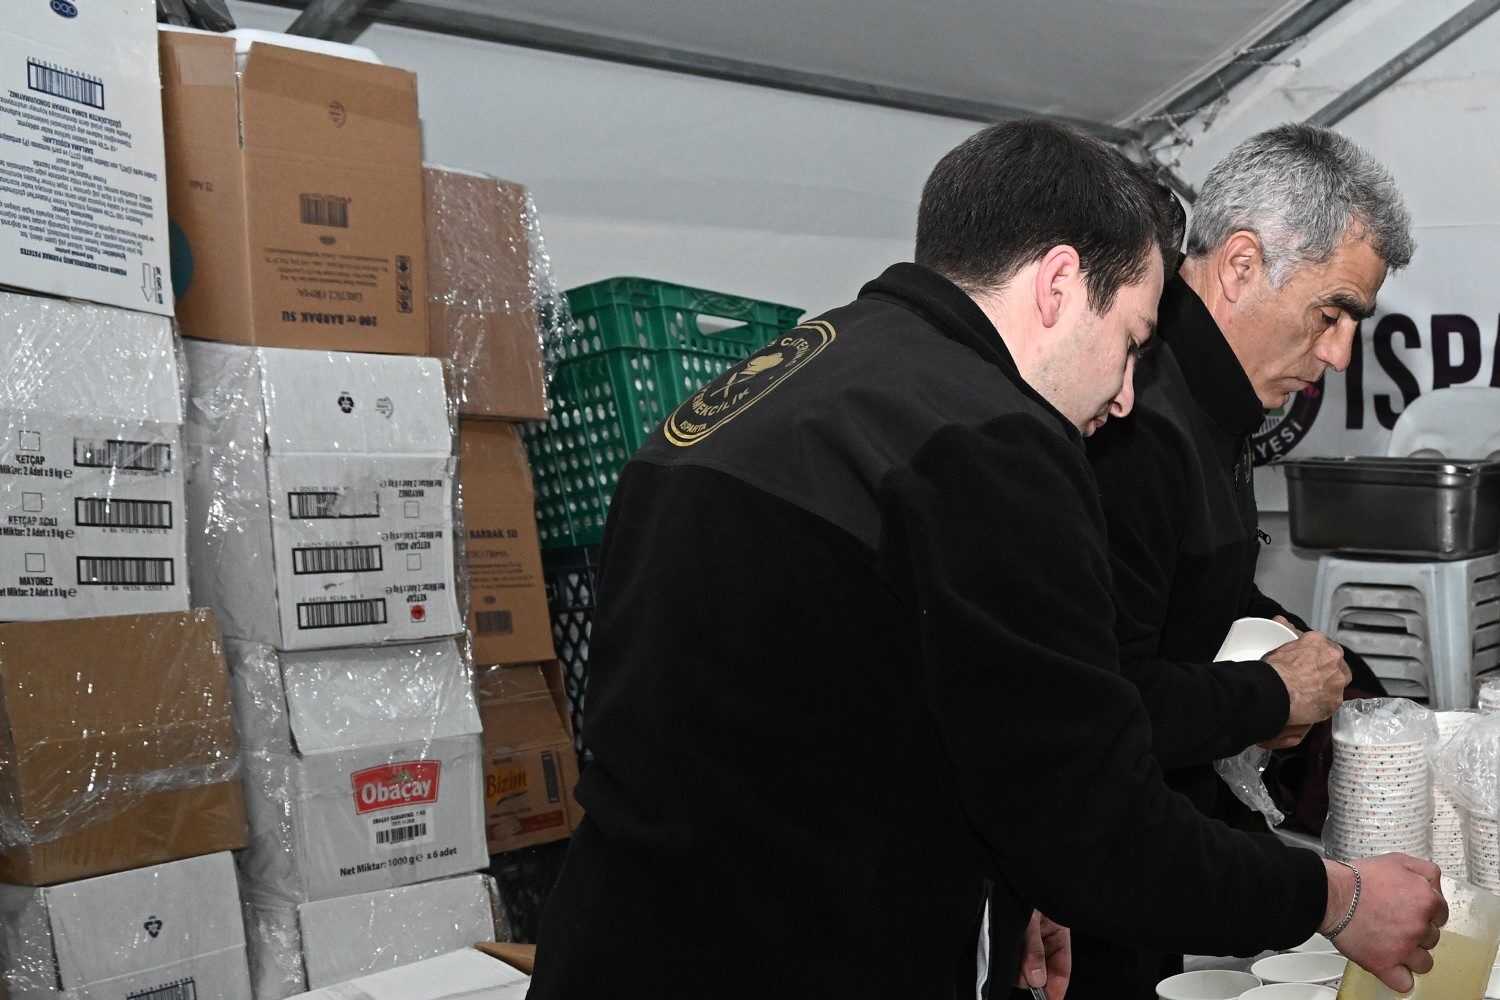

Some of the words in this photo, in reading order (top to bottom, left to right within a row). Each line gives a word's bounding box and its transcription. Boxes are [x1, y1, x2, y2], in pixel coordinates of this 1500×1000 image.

[281, 311, 297, 322] SU
[300, 312, 344, 325] BARDAK
[16, 454, 45, 466] KETÇAP
[8, 515, 37, 528] KETÇAP
[19, 577, 53, 586] MAYONEZ
[361, 780, 431, 804] Obaçay
[340, 867, 355, 877] Net
[357, 862, 386, 874] Miktar:
[388, 856, 408, 867] 1000
[439, 847, 457, 858] adet
